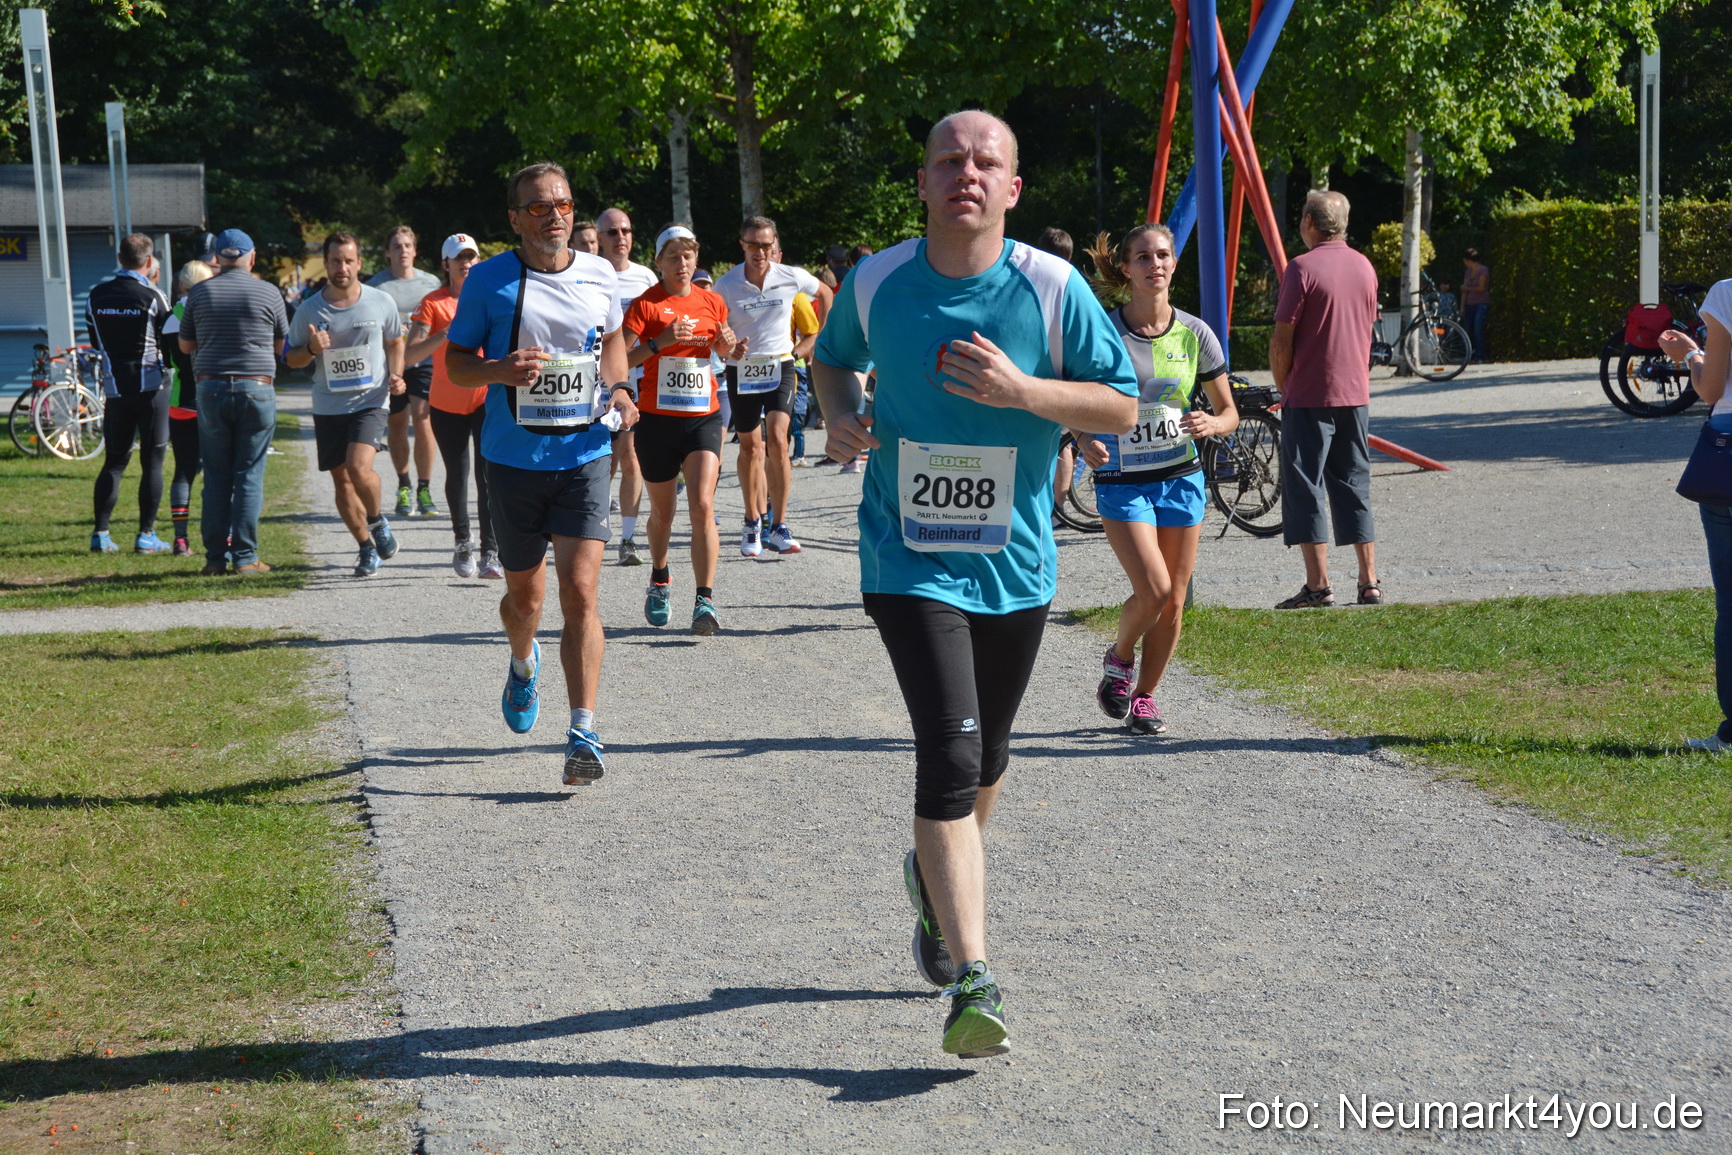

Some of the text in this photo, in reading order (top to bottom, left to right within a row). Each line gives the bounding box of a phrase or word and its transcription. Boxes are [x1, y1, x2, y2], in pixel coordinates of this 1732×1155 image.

[331, 358, 365, 374] 3095
[744, 365, 775, 377] 2347
[529, 372, 583, 395] 2504
[666, 372, 704, 389] 3090
[537, 407, 576, 418] Matthias
[1129, 419, 1179, 444] 3140
[929, 454, 982, 469] BOCK
[912, 473, 995, 509] 2088
[917, 511, 940, 519] PARTL
[918, 526, 981, 541] Reinhard
